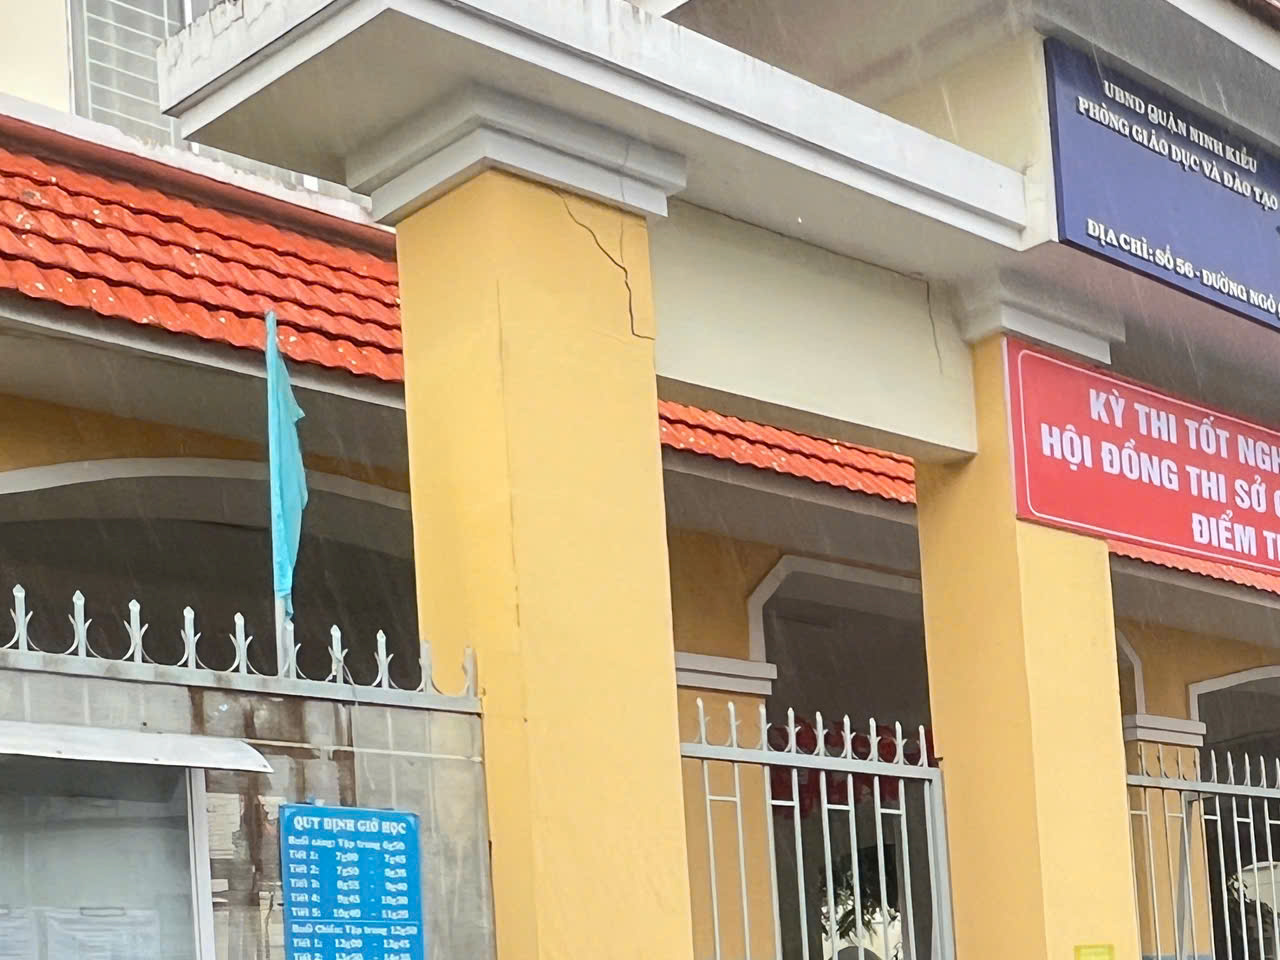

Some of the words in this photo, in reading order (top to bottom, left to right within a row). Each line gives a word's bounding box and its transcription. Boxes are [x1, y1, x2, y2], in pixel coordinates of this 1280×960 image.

[1078, 95, 1130, 140] PHÒNG
[1131, 124, 1169, 157] GIÁO
[1171, 144, 1201, 173] DỤC
[1202, 160, 1222, 184] VÀ
[1223, 169, 1251, 198] ĐÀO
[1254, 186, 1279, 212] TẠO
[1103, 80, 1145, 115] UBND
[1148, 104, 1187, 137] QUẬN
[1189, 125, 1223, 157] NINH
[1087, 217, 1118, 249] ĐỊA
[1175, 259, 1194, 279] 56
[1089, 388, 1126, 428] KỲ
[1134, 402, 1177, 444] THI
[1184, 415, 1230, 459] TỐT
[1040, 423, 1093, 471] HỘI
[1101, 438, 1180, 492] ĐỒNG
[1185, 465, 1227, 504] THI
[1234, 474, 1267, 514] SỞ
[1192, 509, 1257, 556] ĐIỂM
[294, 816, 320, 831] QUY
[381, 821, 407, 835] HỌC
